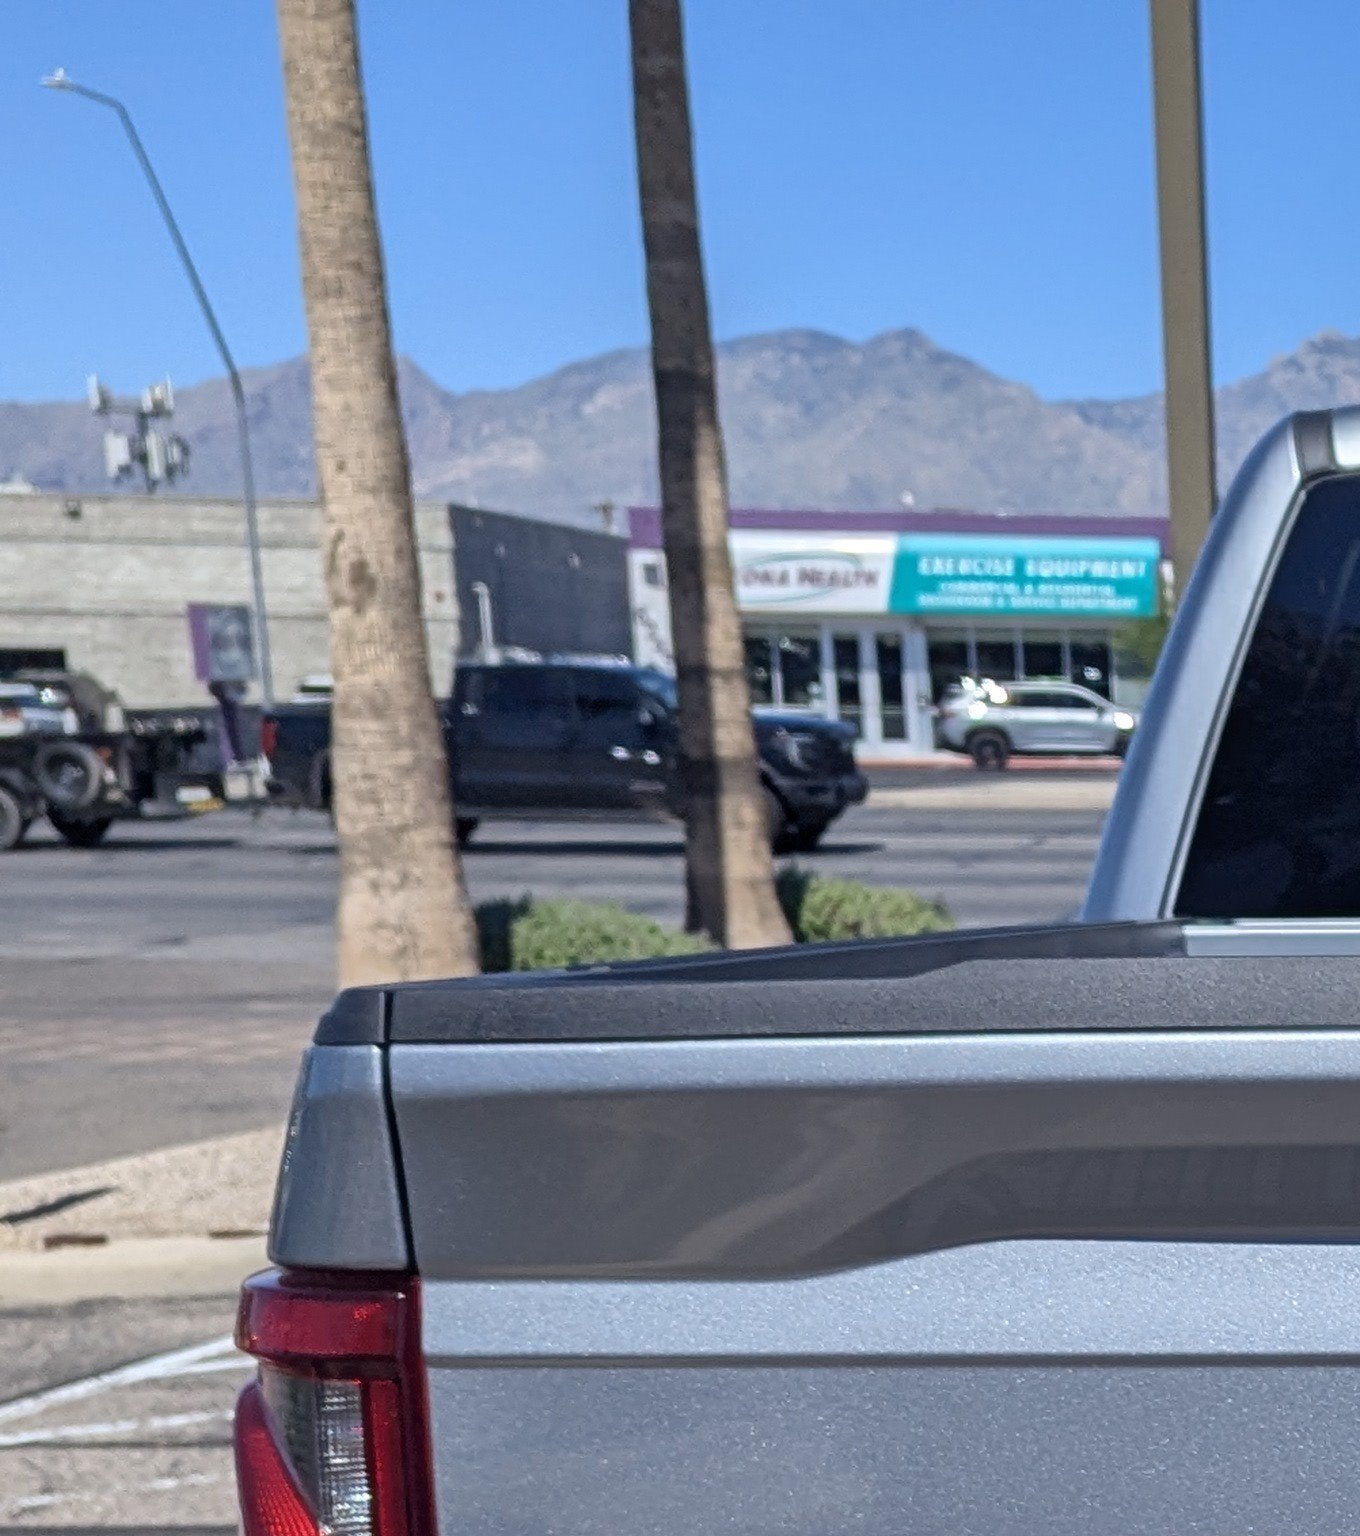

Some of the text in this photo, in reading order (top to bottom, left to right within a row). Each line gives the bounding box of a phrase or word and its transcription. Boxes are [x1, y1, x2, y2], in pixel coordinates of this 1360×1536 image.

[797, 567, 878, 587] HEALTH
[918, 557, 1147, 578] EXERCISE EQUIPMENT
